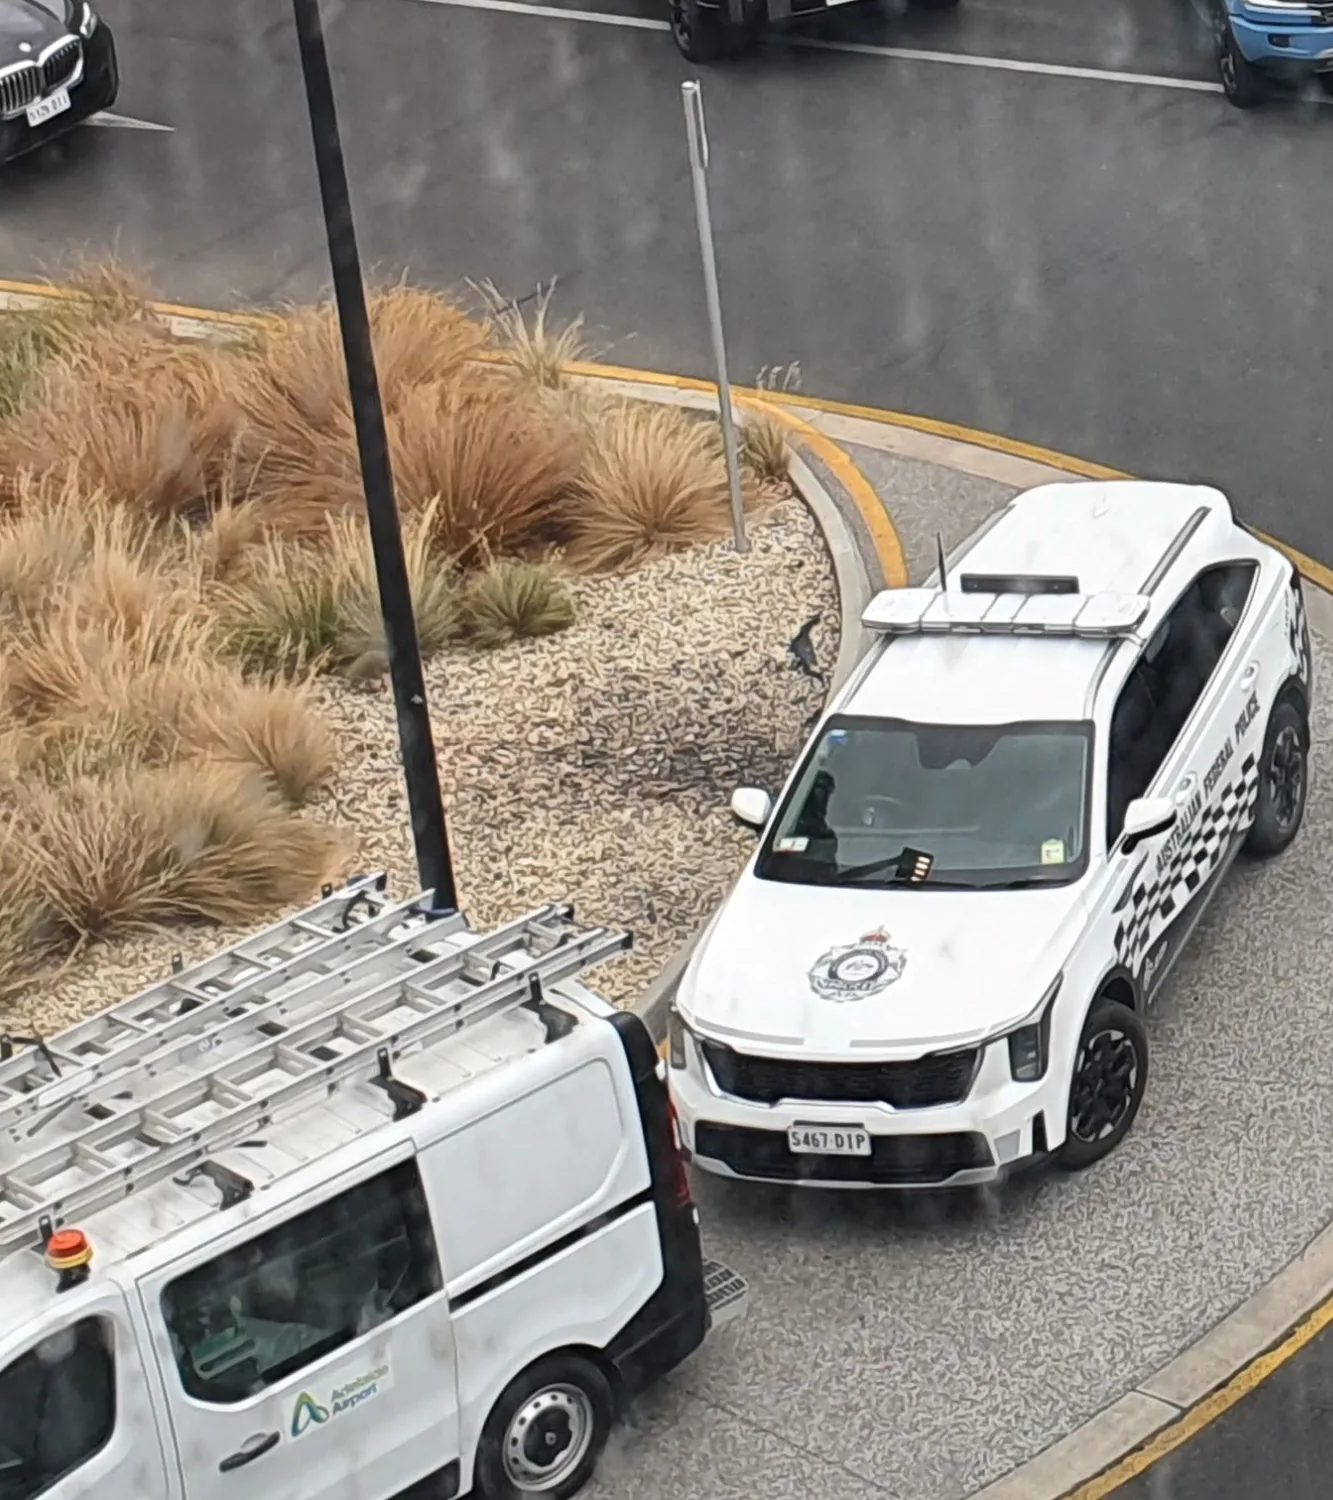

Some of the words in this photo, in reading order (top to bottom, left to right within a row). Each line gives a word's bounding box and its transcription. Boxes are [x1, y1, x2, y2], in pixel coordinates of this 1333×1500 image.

[1156, 789, 1202, 878] AUSTRALIAN
[1203, 736, 1234, 800] FEDERAL
[1234, 690, 1261, 745] POLICE
[791, 1131, 828, 1149] S467
[833, 1132, 866, 1151] DIP
[332, 1382, 378, 1416] Airport
